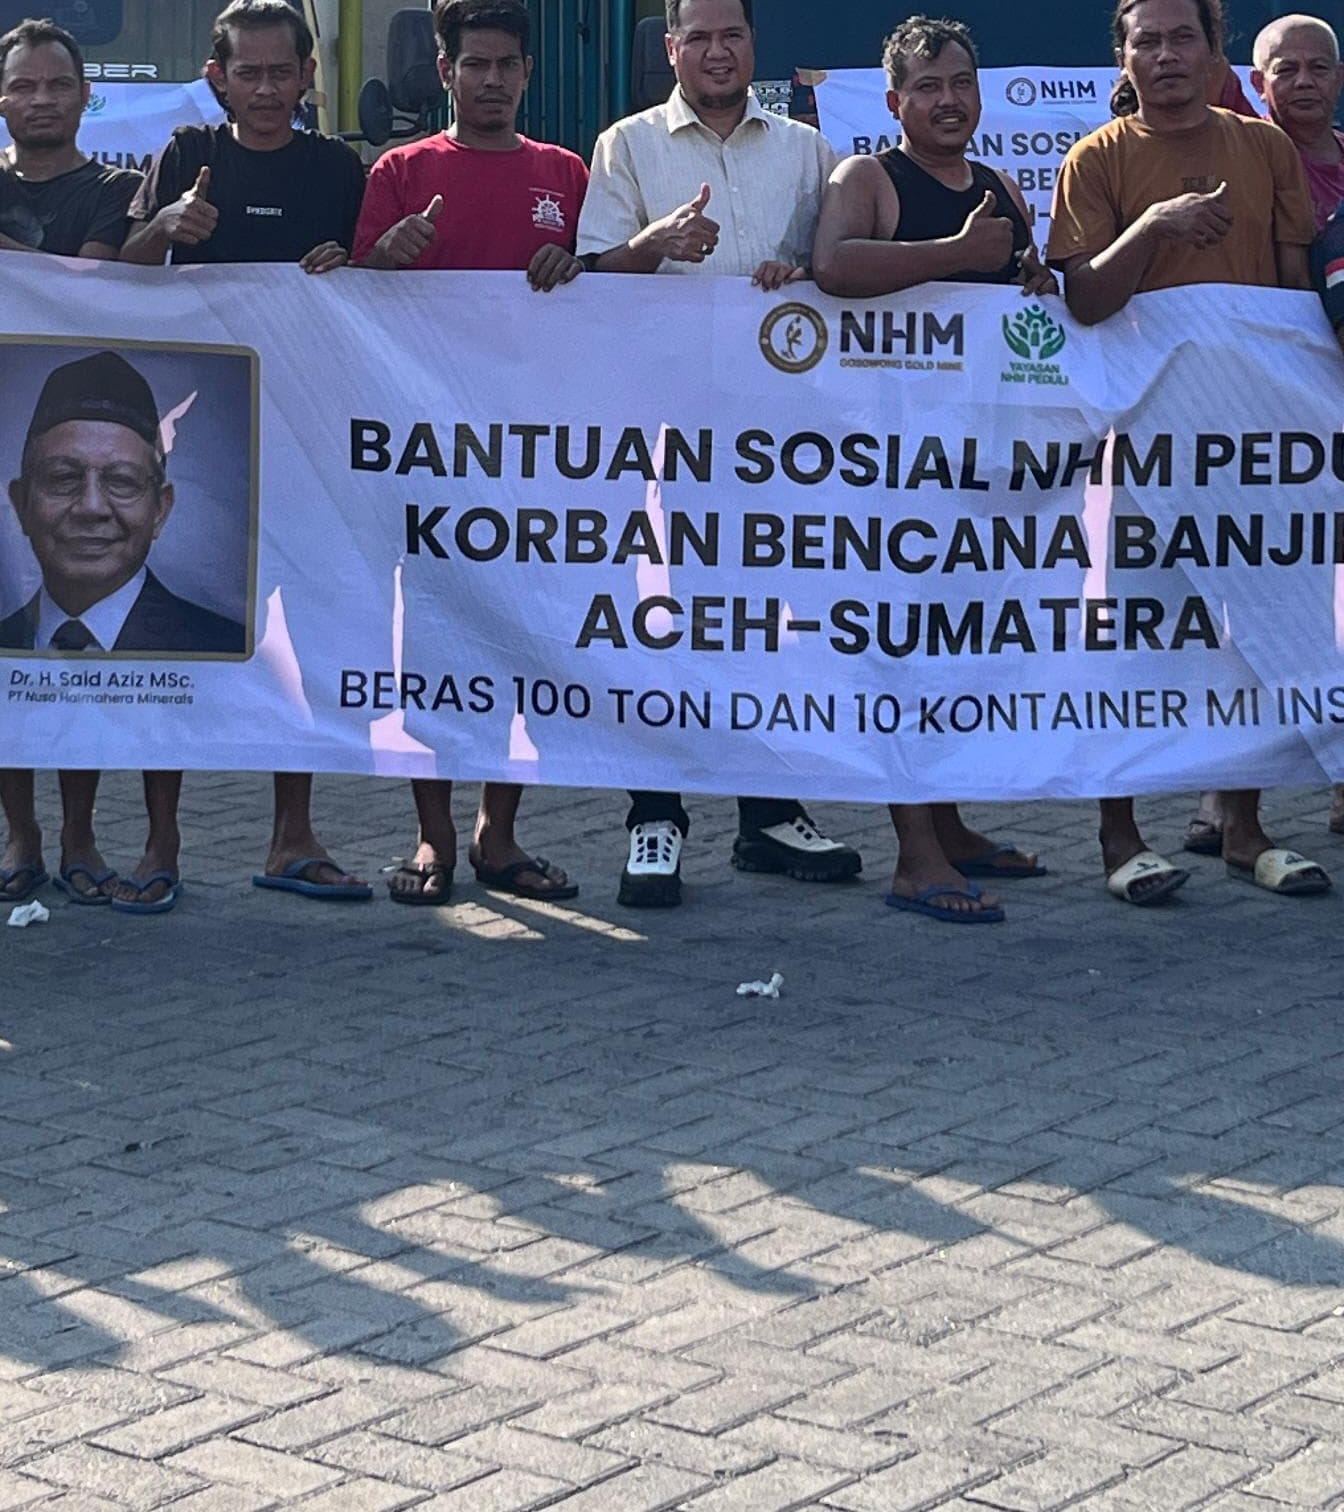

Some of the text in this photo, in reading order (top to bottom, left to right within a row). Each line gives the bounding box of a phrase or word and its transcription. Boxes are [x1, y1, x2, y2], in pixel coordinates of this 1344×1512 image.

[1040, 80, 1096, 99] NHM
[840, 310, 965, 356] NHM
[1000, 372, 1069, 385] NHM PEDULI
[1009, 361, 1061, 374] YAYASAN
[350, 418, 713, 482] BANTUAN
[734, 429, 990, 491] SOSIAL
[1008, 432, 1173, 492] NHM
[405, 504, 719, 566] KORBAN
[742, 513, 1092, 574] BENCANA
[575, 593, 1221, 657] ACEH-SUMATERA
[10, 670, 195, 688] Dr. H. Said Aziz MSc.
[8, 690, 194, 705] PT Nusa Halmahera Minerals
[340, 669, 495, 714] BERAS
[513, 676, 591, 719] 100
[607, 688, 712, 731] TON
[730, 691, 836, 733] DAN
[853, 692, 901, 734] 10
[919, 688, 1188, 735] KONTAINER
[1206, 688, 1260, 727] MI
